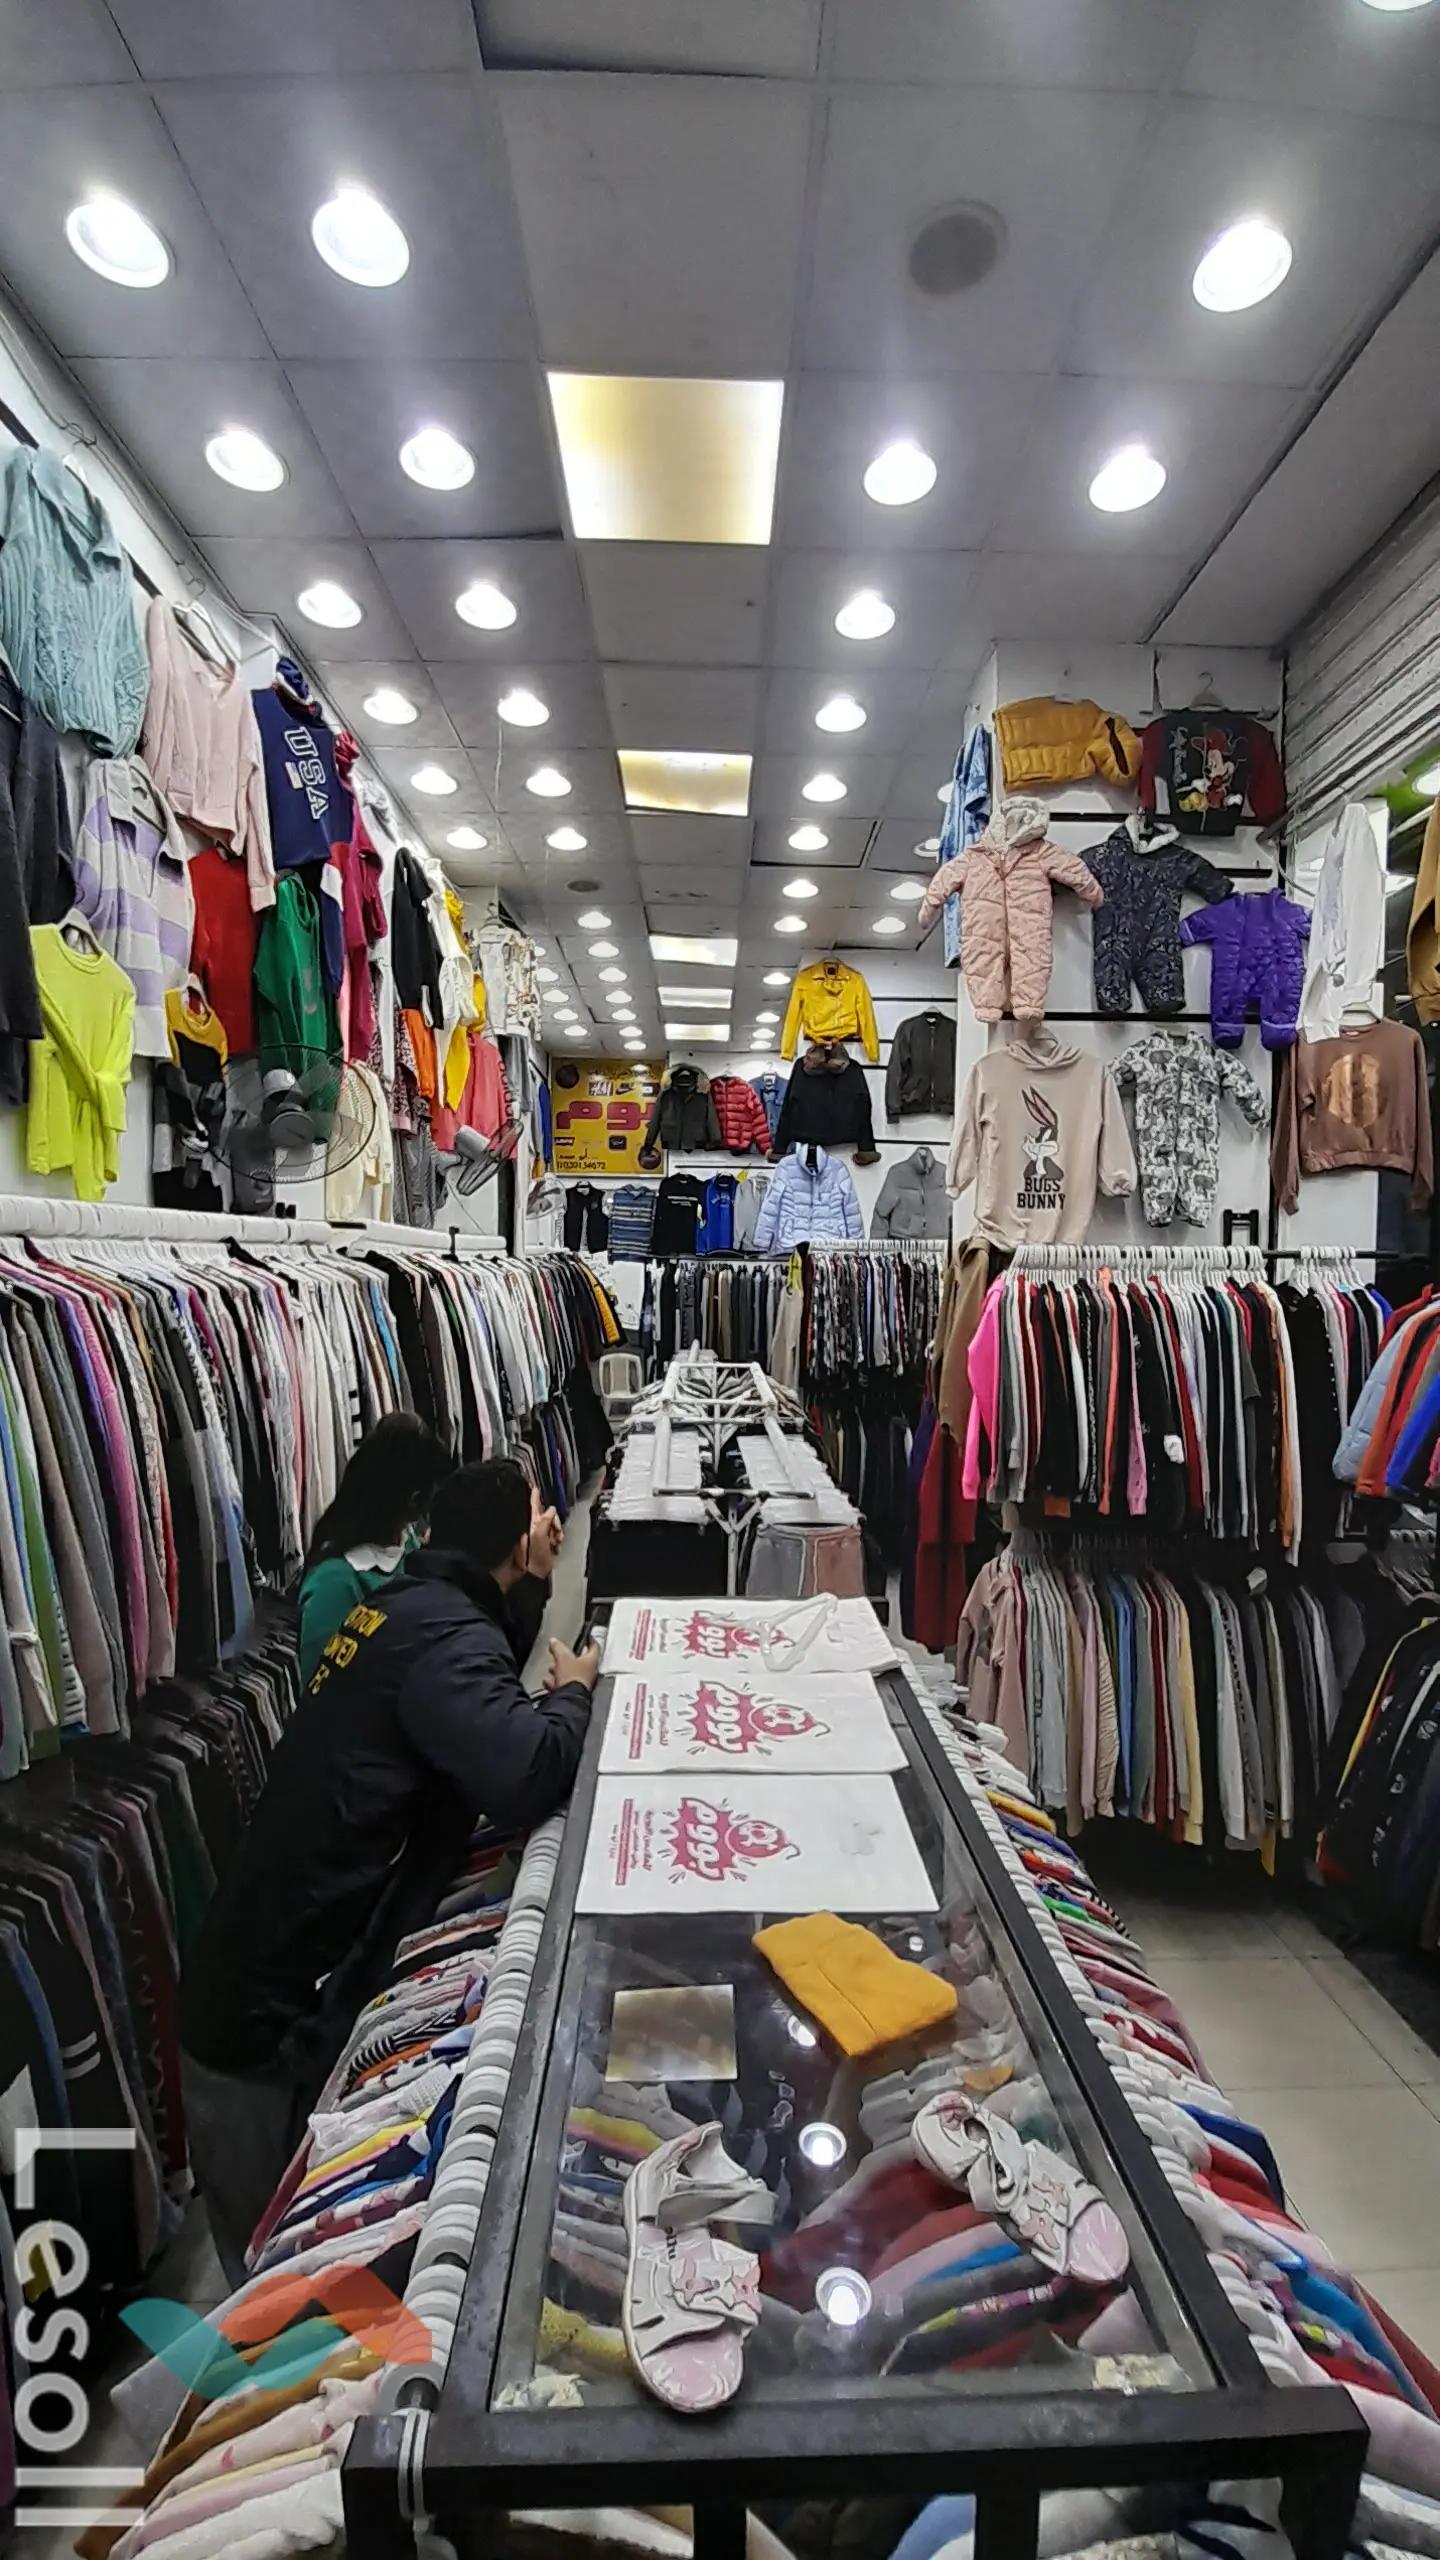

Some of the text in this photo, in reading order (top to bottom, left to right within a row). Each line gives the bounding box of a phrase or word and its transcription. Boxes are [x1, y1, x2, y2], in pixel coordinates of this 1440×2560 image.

[283, 727, 329, 821] USA
[1016, 1193, 1066, 1210] BUNNY
[1024, 1177, 1061, 1192] BUGS
[684, 1800, 720, 1879] بووم
